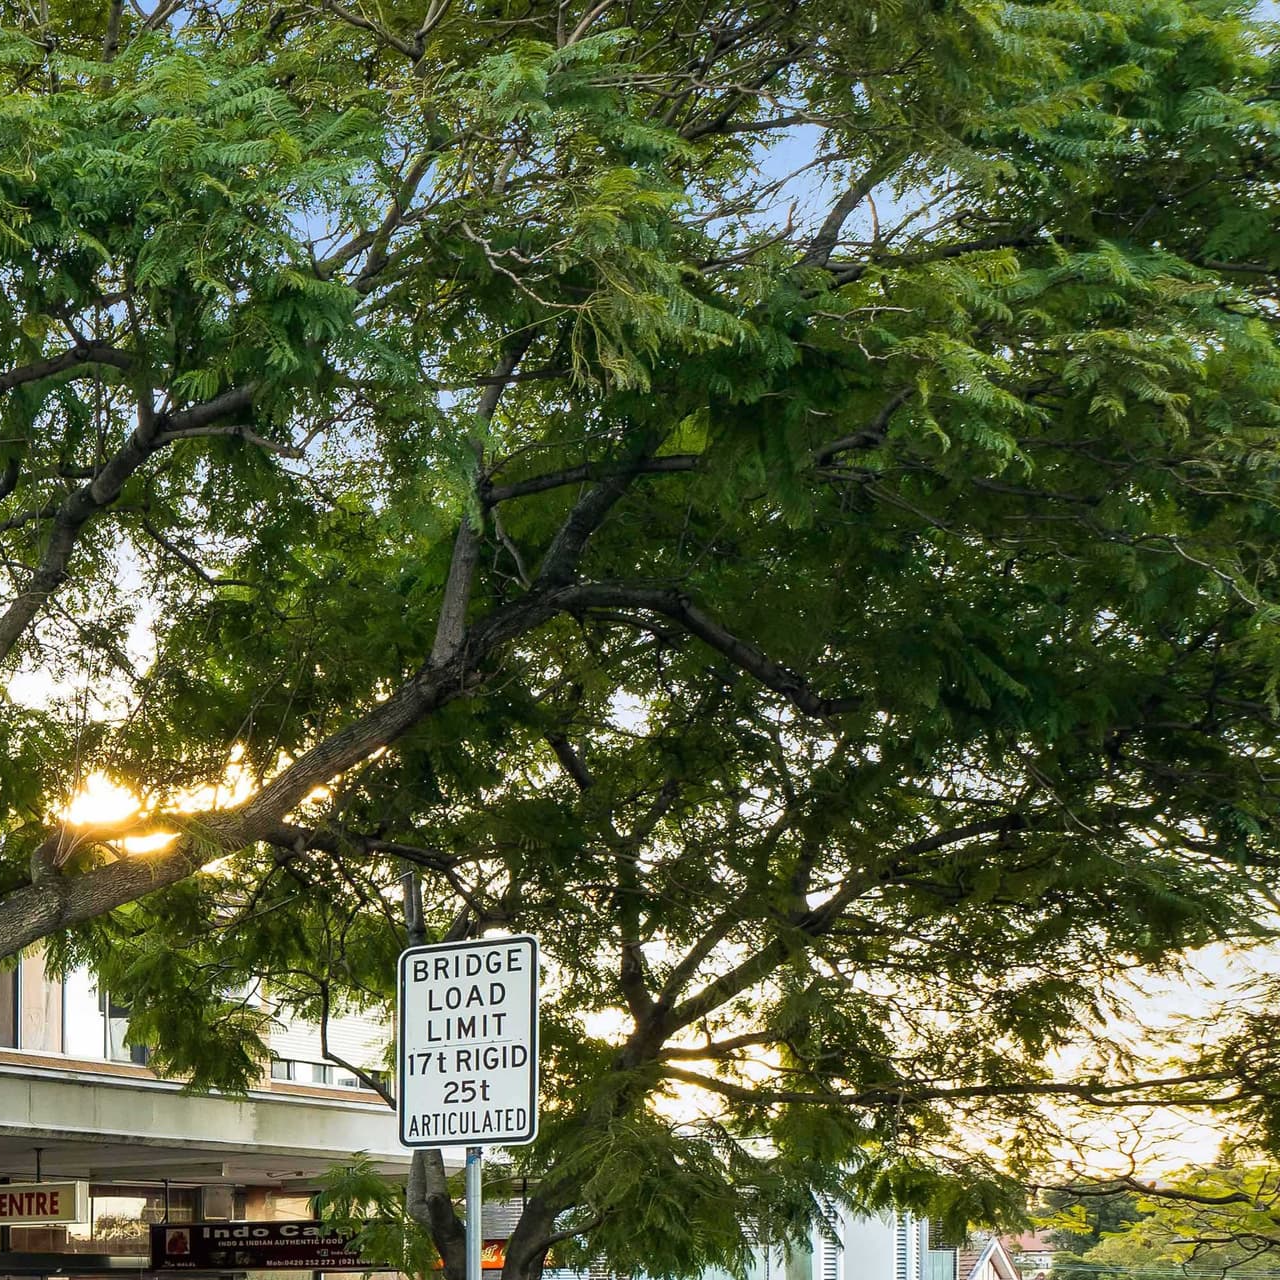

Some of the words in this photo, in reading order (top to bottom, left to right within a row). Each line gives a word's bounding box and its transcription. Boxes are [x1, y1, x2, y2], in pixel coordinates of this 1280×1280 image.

[413, 949, 522, 982] BRIDGE
[428, 982, 506, 1012] LOAD
[427, 1012, 507, 1042] LIMIT
[456, 1045, 528, 1072] RIGID
[443, 1079, 490, 1105] 25t
[408, 1108, 527, 1137] ARTICULATED
[202, 1226, 269, 1239] Indo
